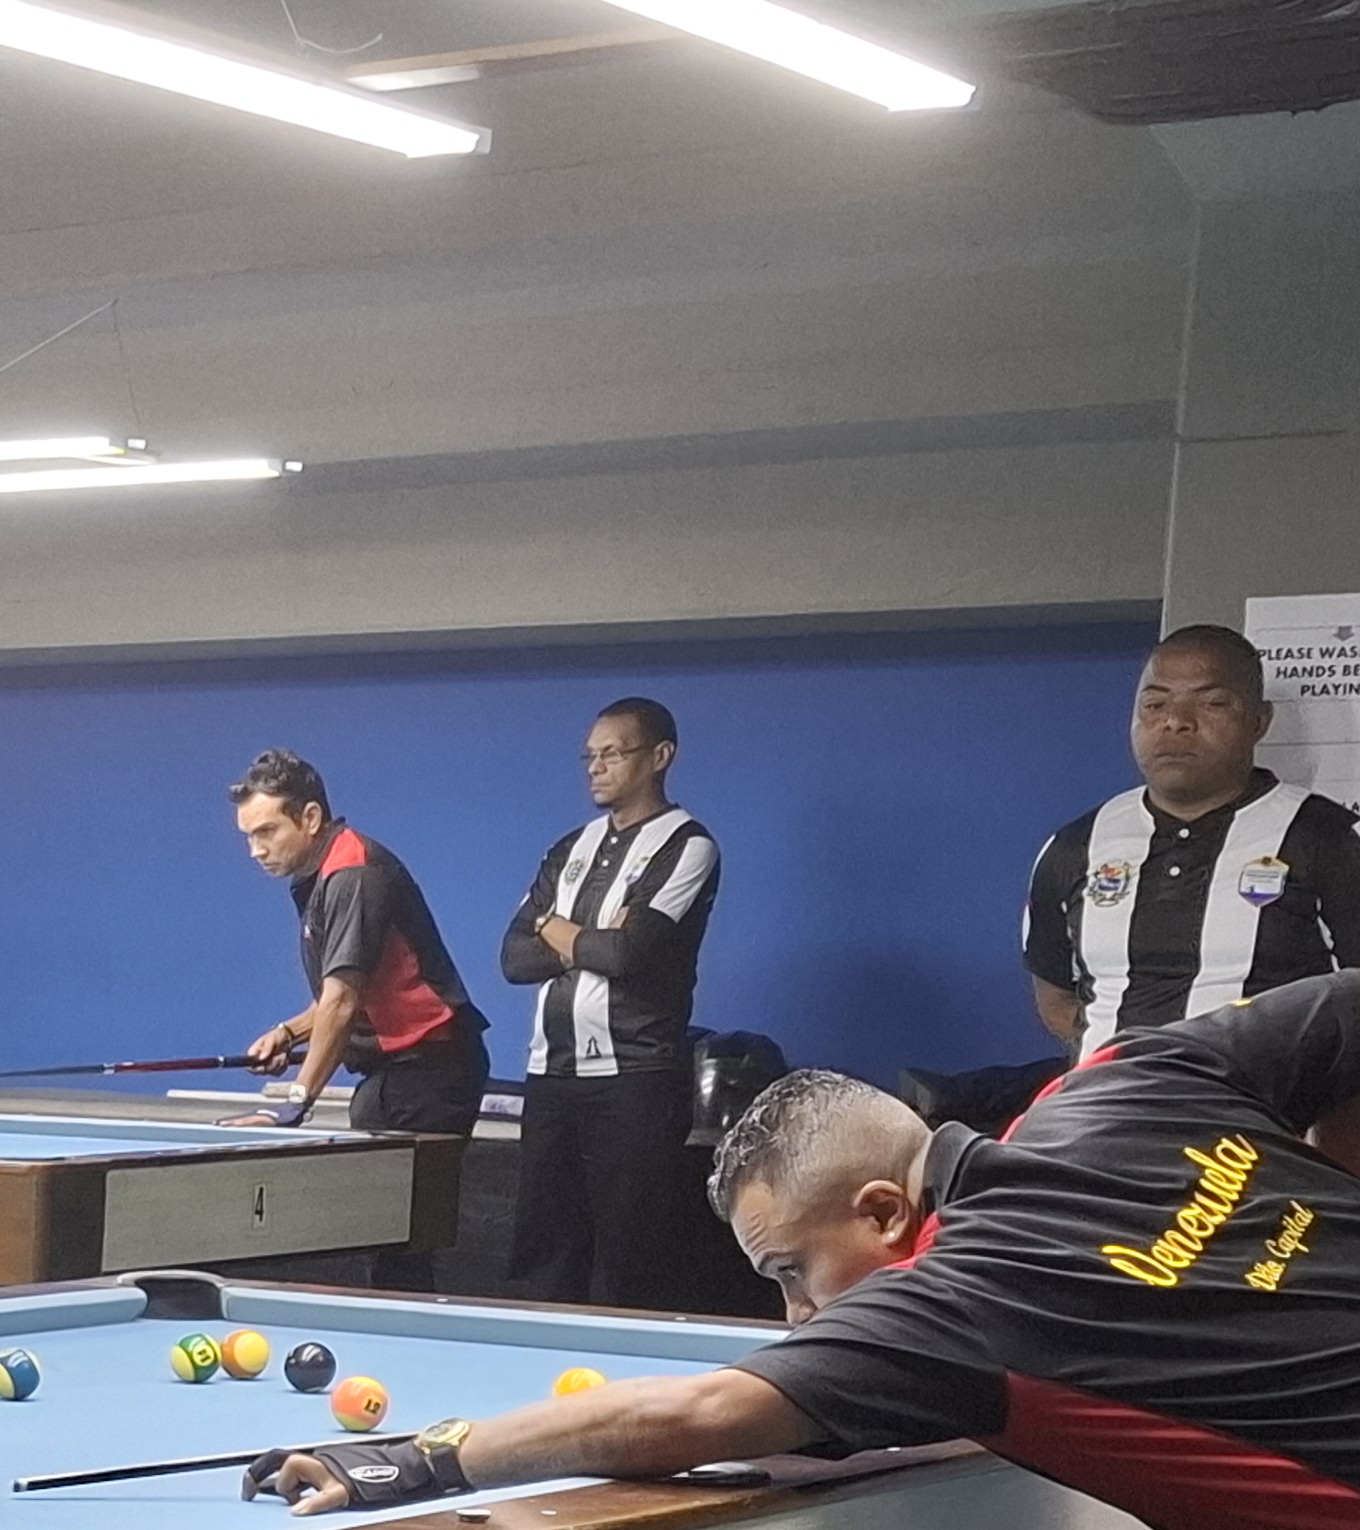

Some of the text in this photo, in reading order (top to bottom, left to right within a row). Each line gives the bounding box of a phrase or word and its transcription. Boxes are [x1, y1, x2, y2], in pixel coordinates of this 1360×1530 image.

[1260, 645, 1360, 661] PLEASE WAS
[1275, 665, 1337, 679] HANDS
[254, 1186, 265, 1222] 4
[1100, 1132, 1260, 1287] Venezuela
[1264, 1200, 1315, 1256] Capital
